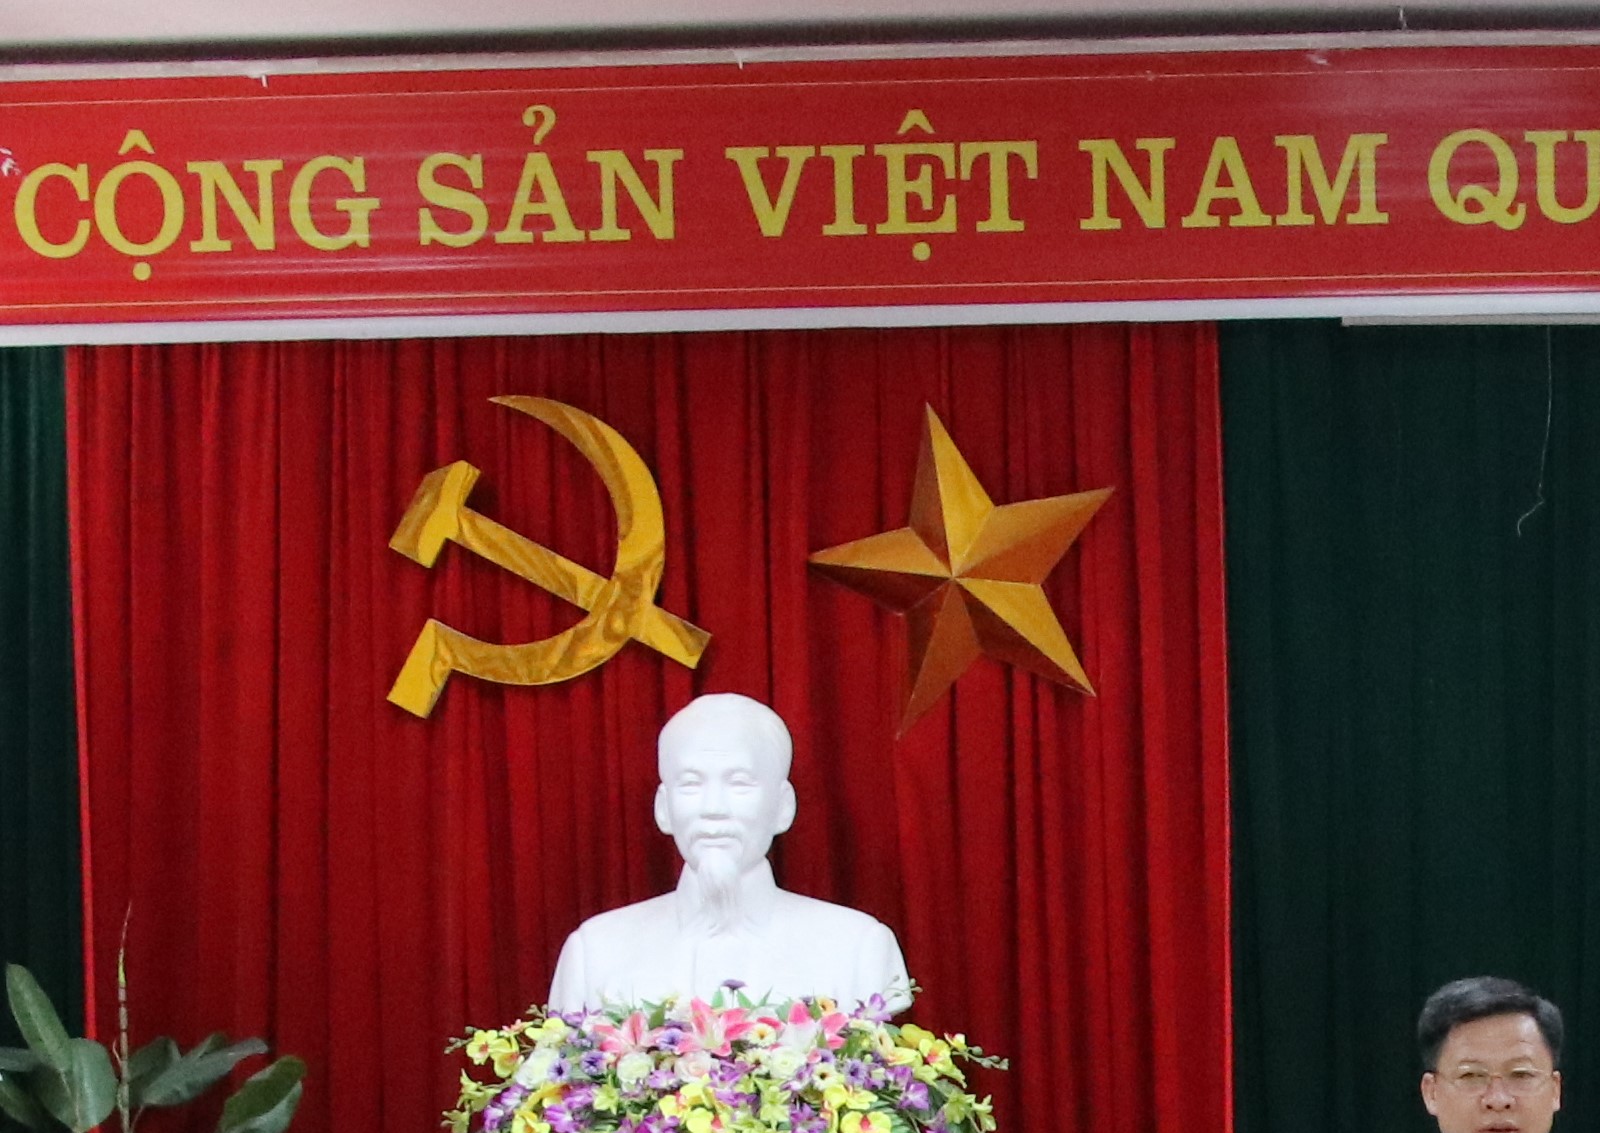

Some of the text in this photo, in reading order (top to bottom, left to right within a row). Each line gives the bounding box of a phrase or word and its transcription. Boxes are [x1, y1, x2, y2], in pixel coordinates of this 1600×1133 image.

[15, 130, 381, 281] CỘNG
[417, 105, 684, 248] SẢN
[726, 109, 1038, 261] VIỆT
[1079, 132, 1390, 231] NAM
